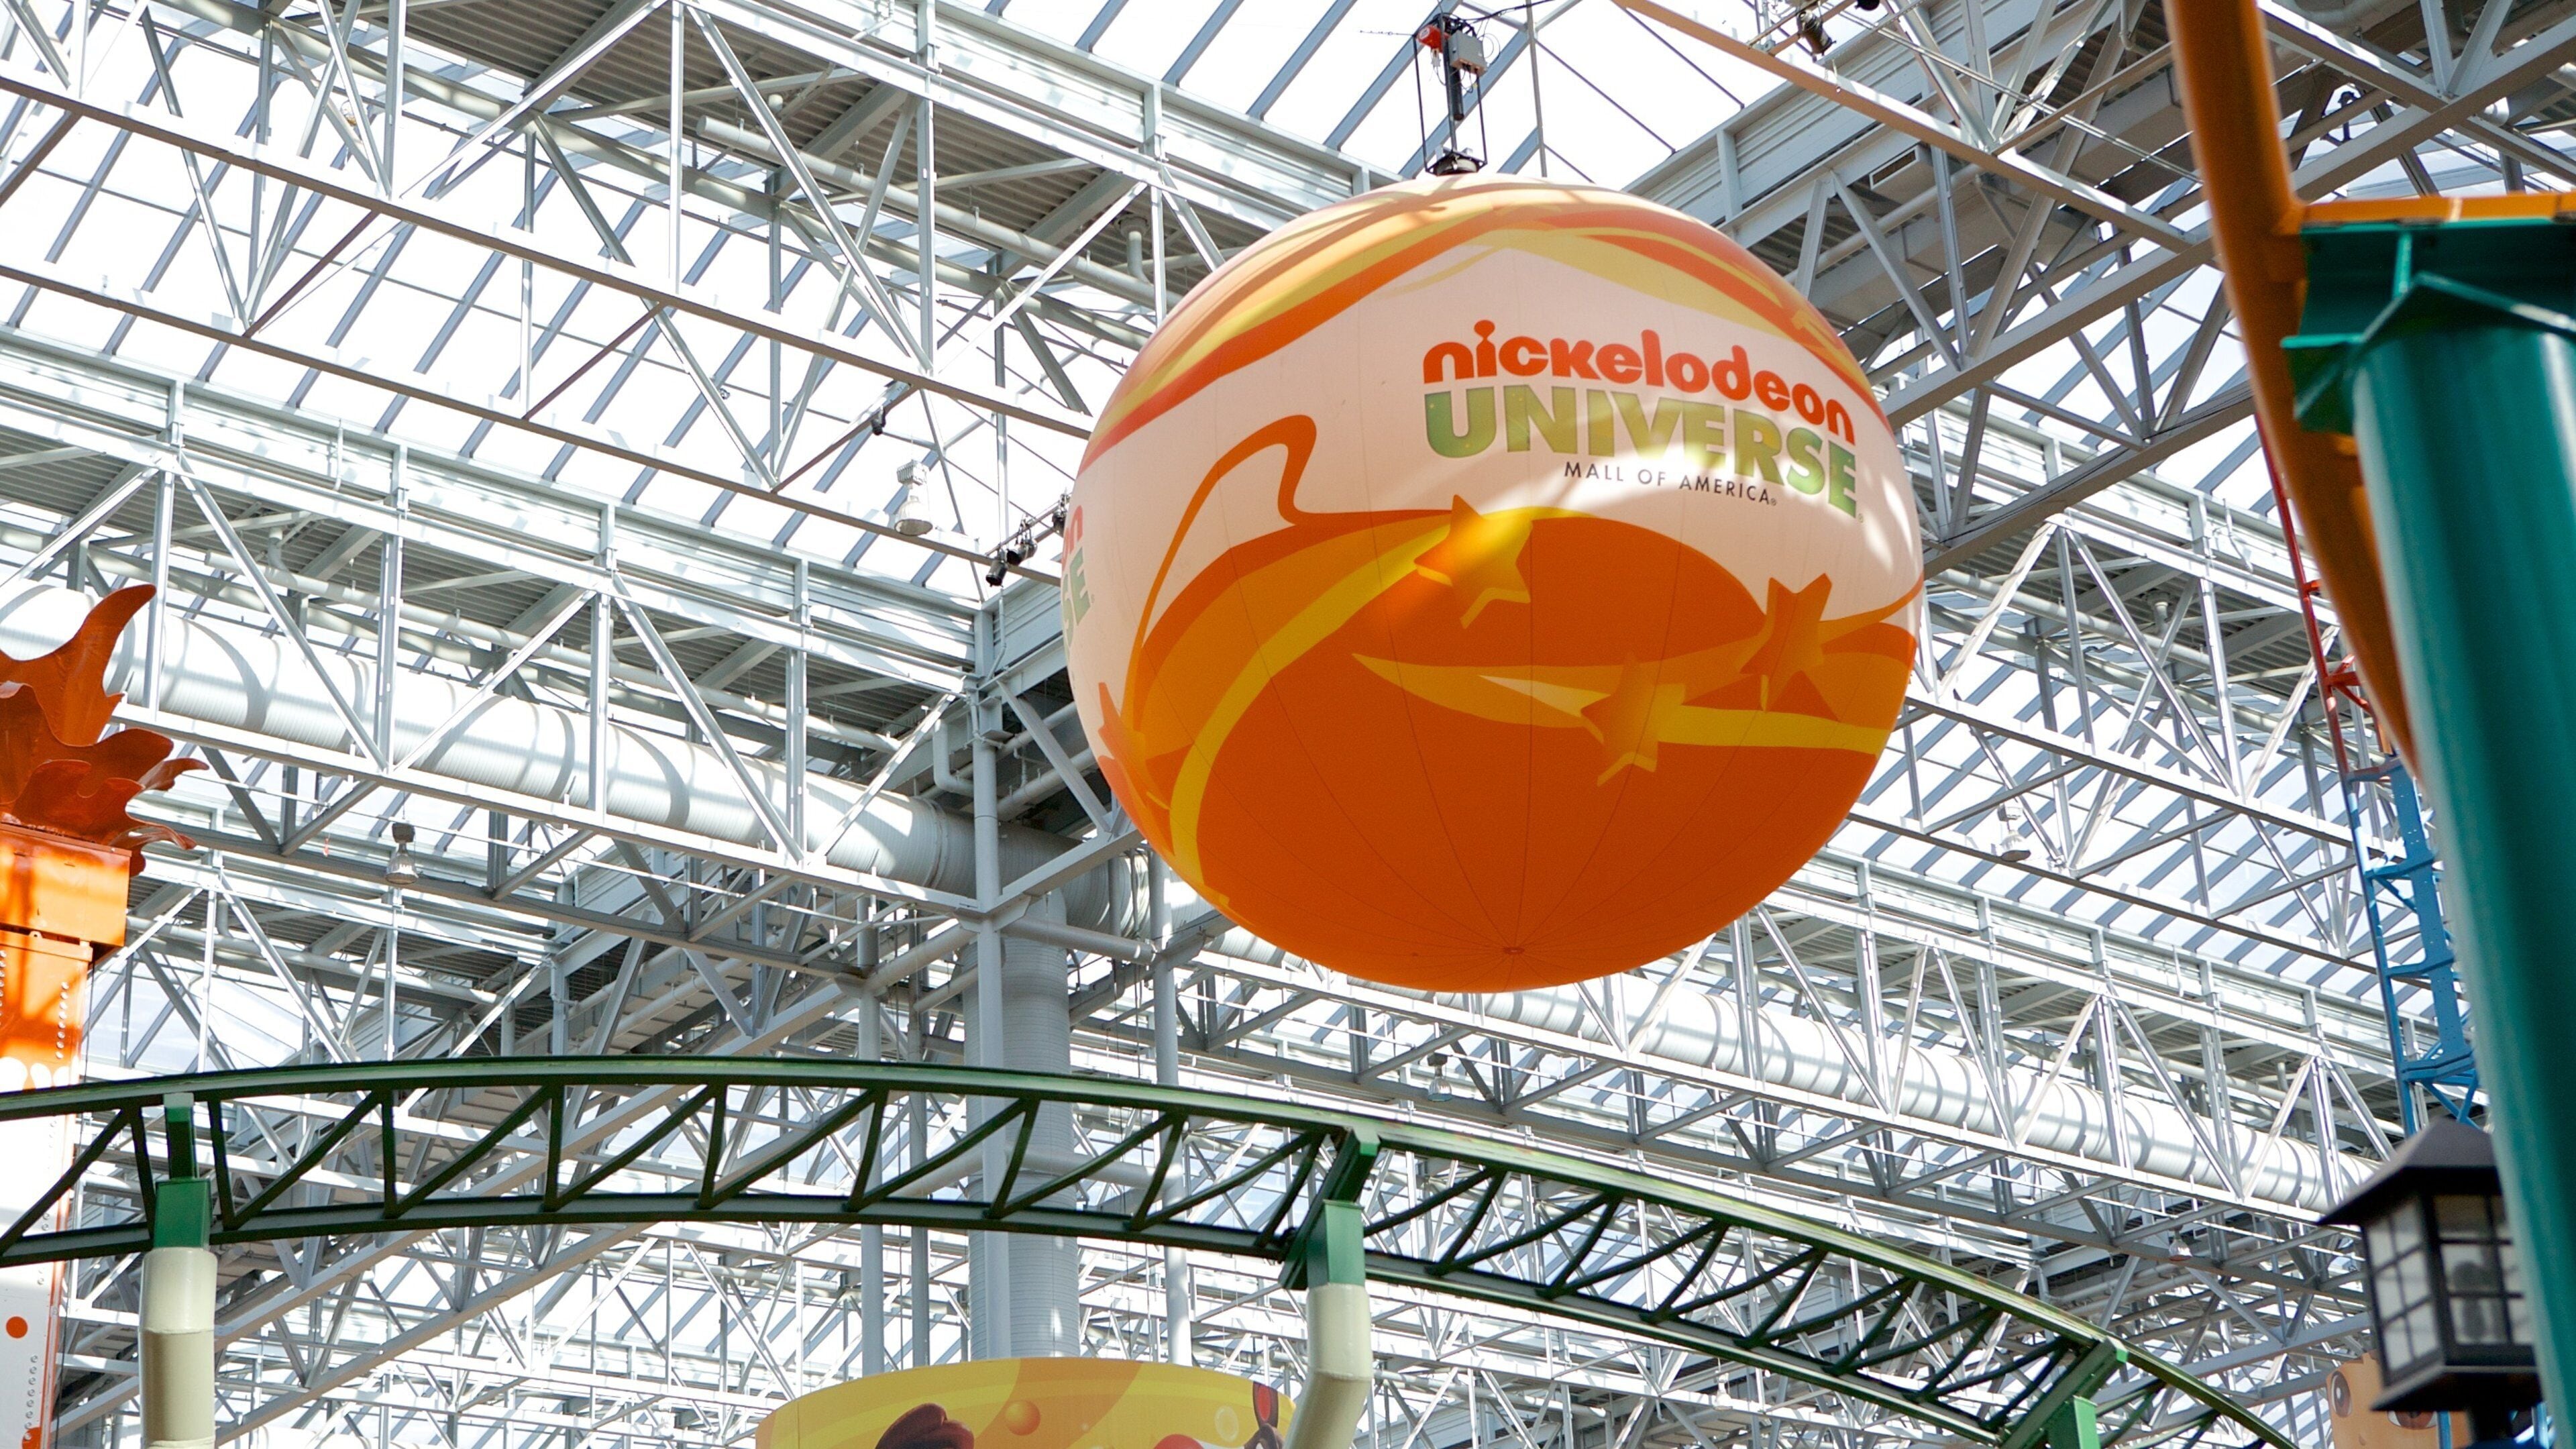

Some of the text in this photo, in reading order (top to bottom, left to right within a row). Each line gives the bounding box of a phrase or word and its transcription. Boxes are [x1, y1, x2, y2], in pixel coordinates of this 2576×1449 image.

[1423, 319, 1856, 446] nickelodeon
[1424, 384, 1857, 519] UNIVERSE
[1564, 461, 1623, 482] MALL
[1638, 469, 1666, 486] OF
